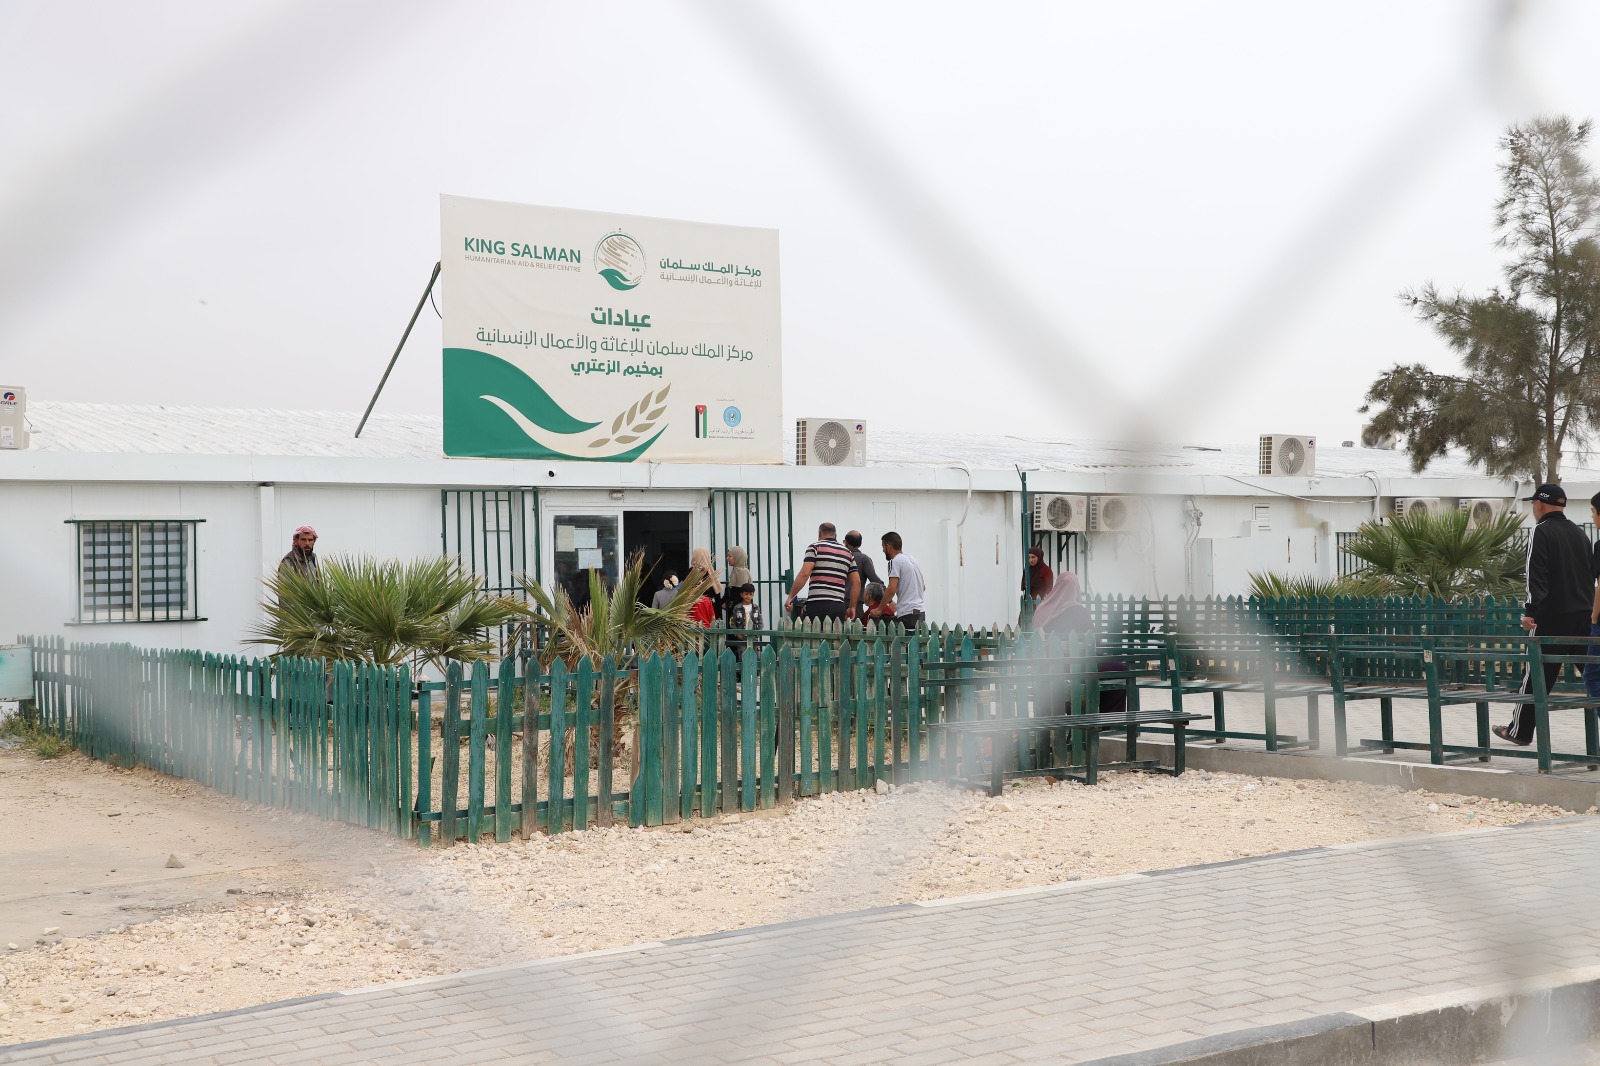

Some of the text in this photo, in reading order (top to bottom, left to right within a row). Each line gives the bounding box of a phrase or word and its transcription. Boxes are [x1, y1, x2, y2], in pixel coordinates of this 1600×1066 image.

[464, 237, 581, 264] KING SALMAN
[464, 254, 517, 266] HUMANITARIAN
[535, 262, 556, 270] RELIEF
[556, 264, 581, 273] CENTRE
[659, 258, 762, 277] مركز الملك سلمان
[590, 306, 651, 332] عيادات
[476, 326, 753, 361] مركز الملك سلمان للإغاثة والأعمال الإنسانية
[570, 358, 663, 379] بمخيم الزعتري
